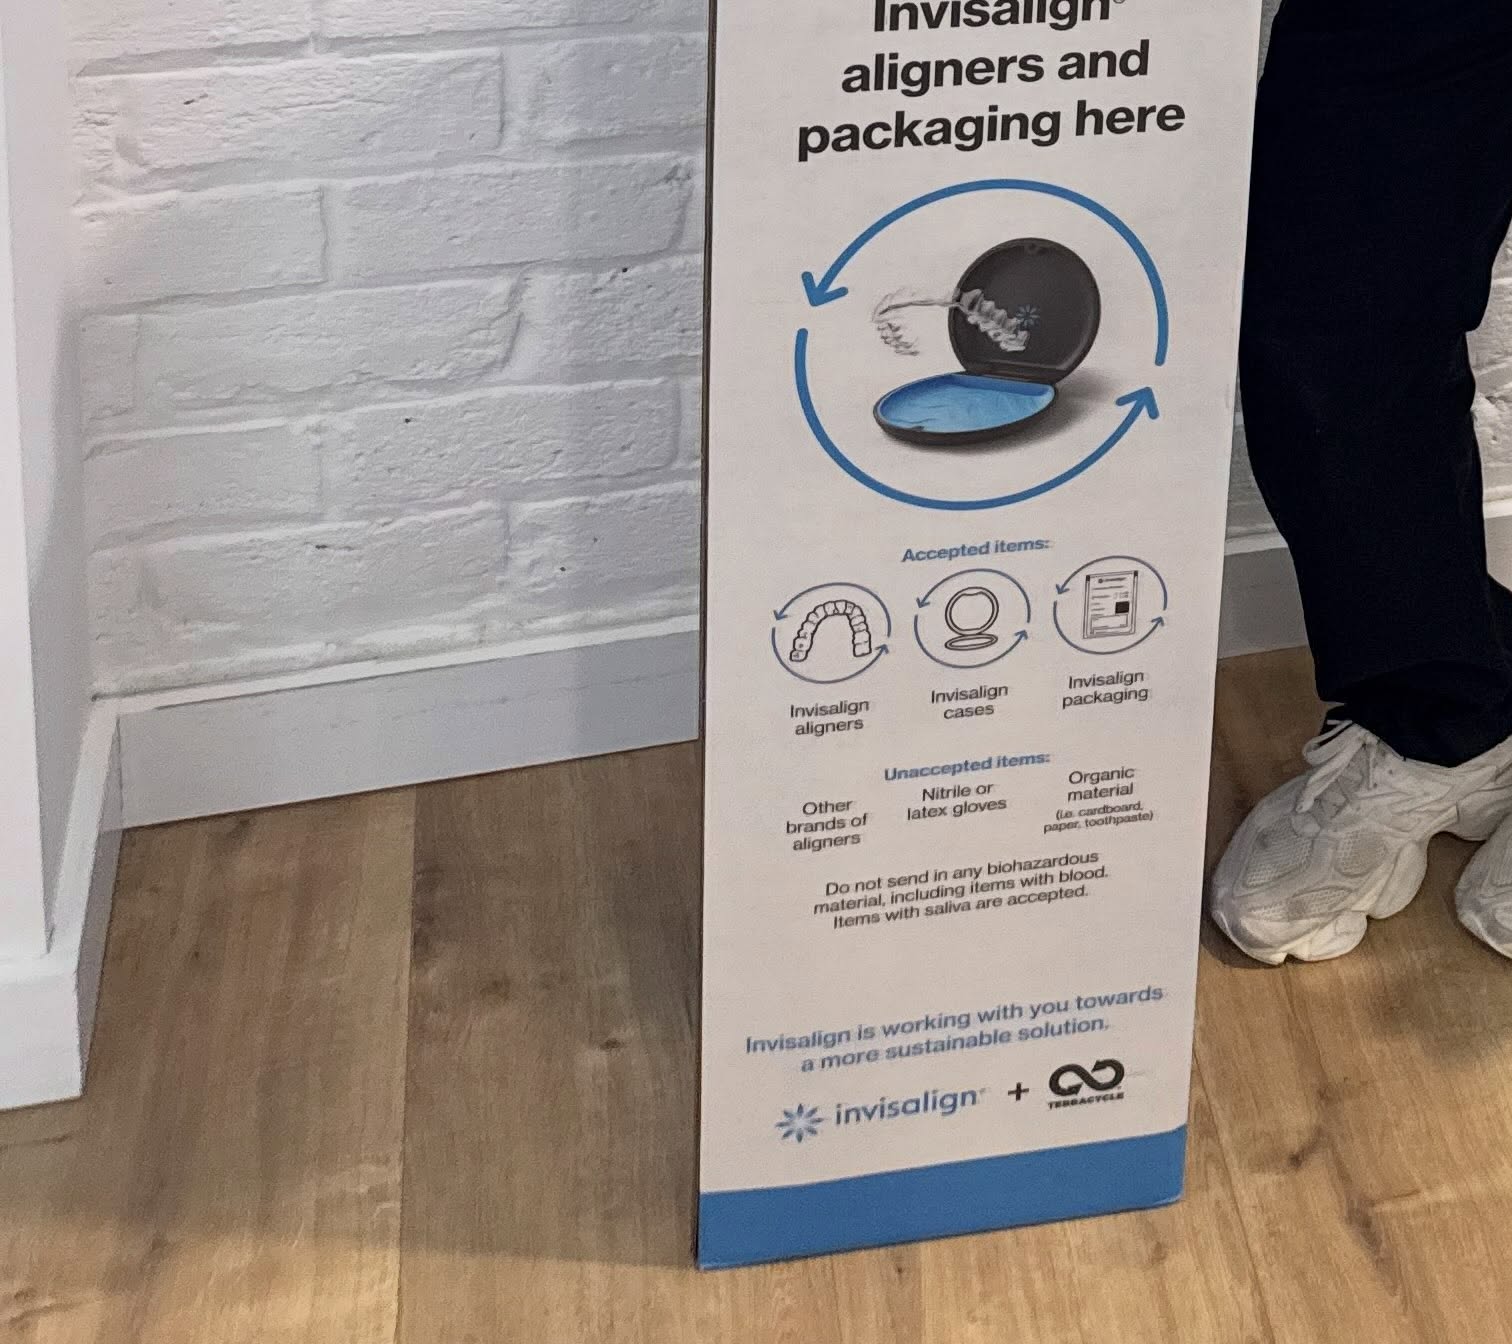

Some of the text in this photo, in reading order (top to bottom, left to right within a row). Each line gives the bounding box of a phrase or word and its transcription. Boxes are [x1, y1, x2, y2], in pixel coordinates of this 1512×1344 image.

[841, 39, 1149, 97] aligners and
[798, 100, 1186, 163] packaging here
[901, 537, 1050, 564] Accepted items:
[1068, 670, 1145, 690] Invisalign
[930, 684, 1009, 705] Invisalign
[1062, 687, 1149, 711] packaging
[789, 699, 870, 720] Invisalign
[943, 702, 995, 721] cases
[794, 717, 864, 738] aligners
[883, 751, 1050, 782] Unaccepted items:
[1068, 767, 1135, 786] Organic
[921, 783, 993, 804] Nitrile or
[1066, 783, 1134, 803] material
[802, 797, 853, 817] Other
[906, 797, 1007, 821] latex gloves
[786, 813, 868, 835] brands of
[793, 831, 861, 853] aligners
[825, 850, 1099, 897] Do not send in any biohazardous
[814, 866, 1108, 916] material, including items with blood.
[833, 884, 1089, 930] Items with saliva are accepted.
[746, 984, 1164, 1055] Invisalign is working with you towards
[800, 1016, 1109, 1072] a more sustainable solution.
